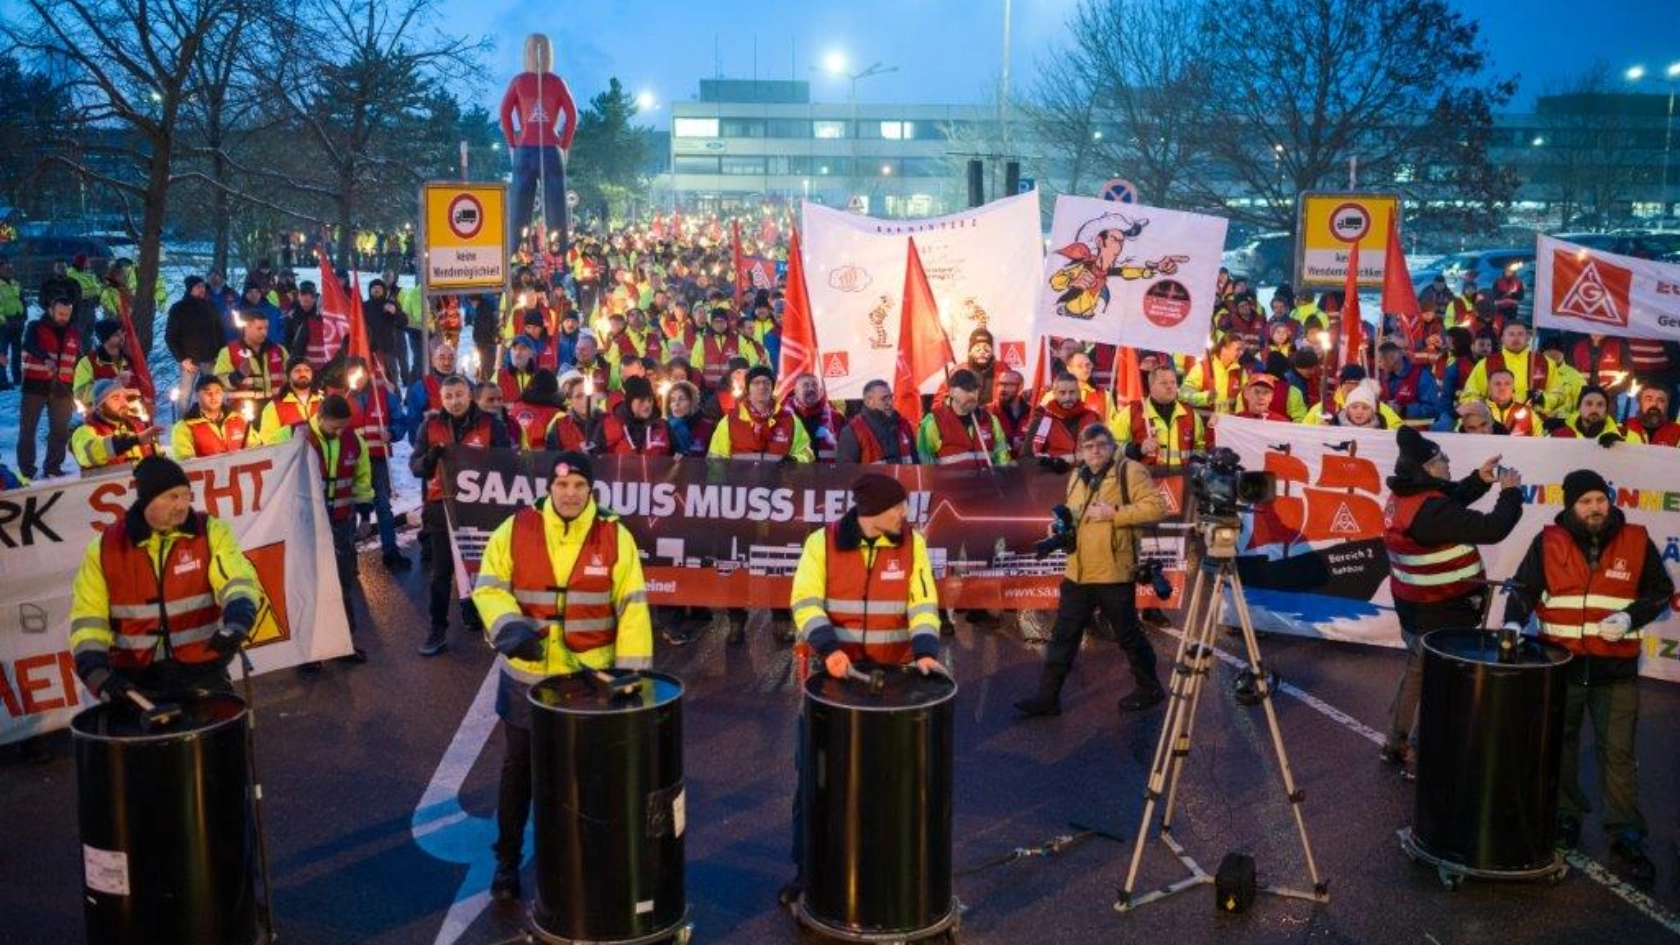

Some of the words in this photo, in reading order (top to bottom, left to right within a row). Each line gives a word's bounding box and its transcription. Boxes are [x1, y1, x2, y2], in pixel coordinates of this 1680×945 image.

[0, 490, 64, 548] RK
[684, 484, 794, 522] MUSS
[1328, 548, 1365, 563] Bereich
[1366, 547, 1374, 559] 2
